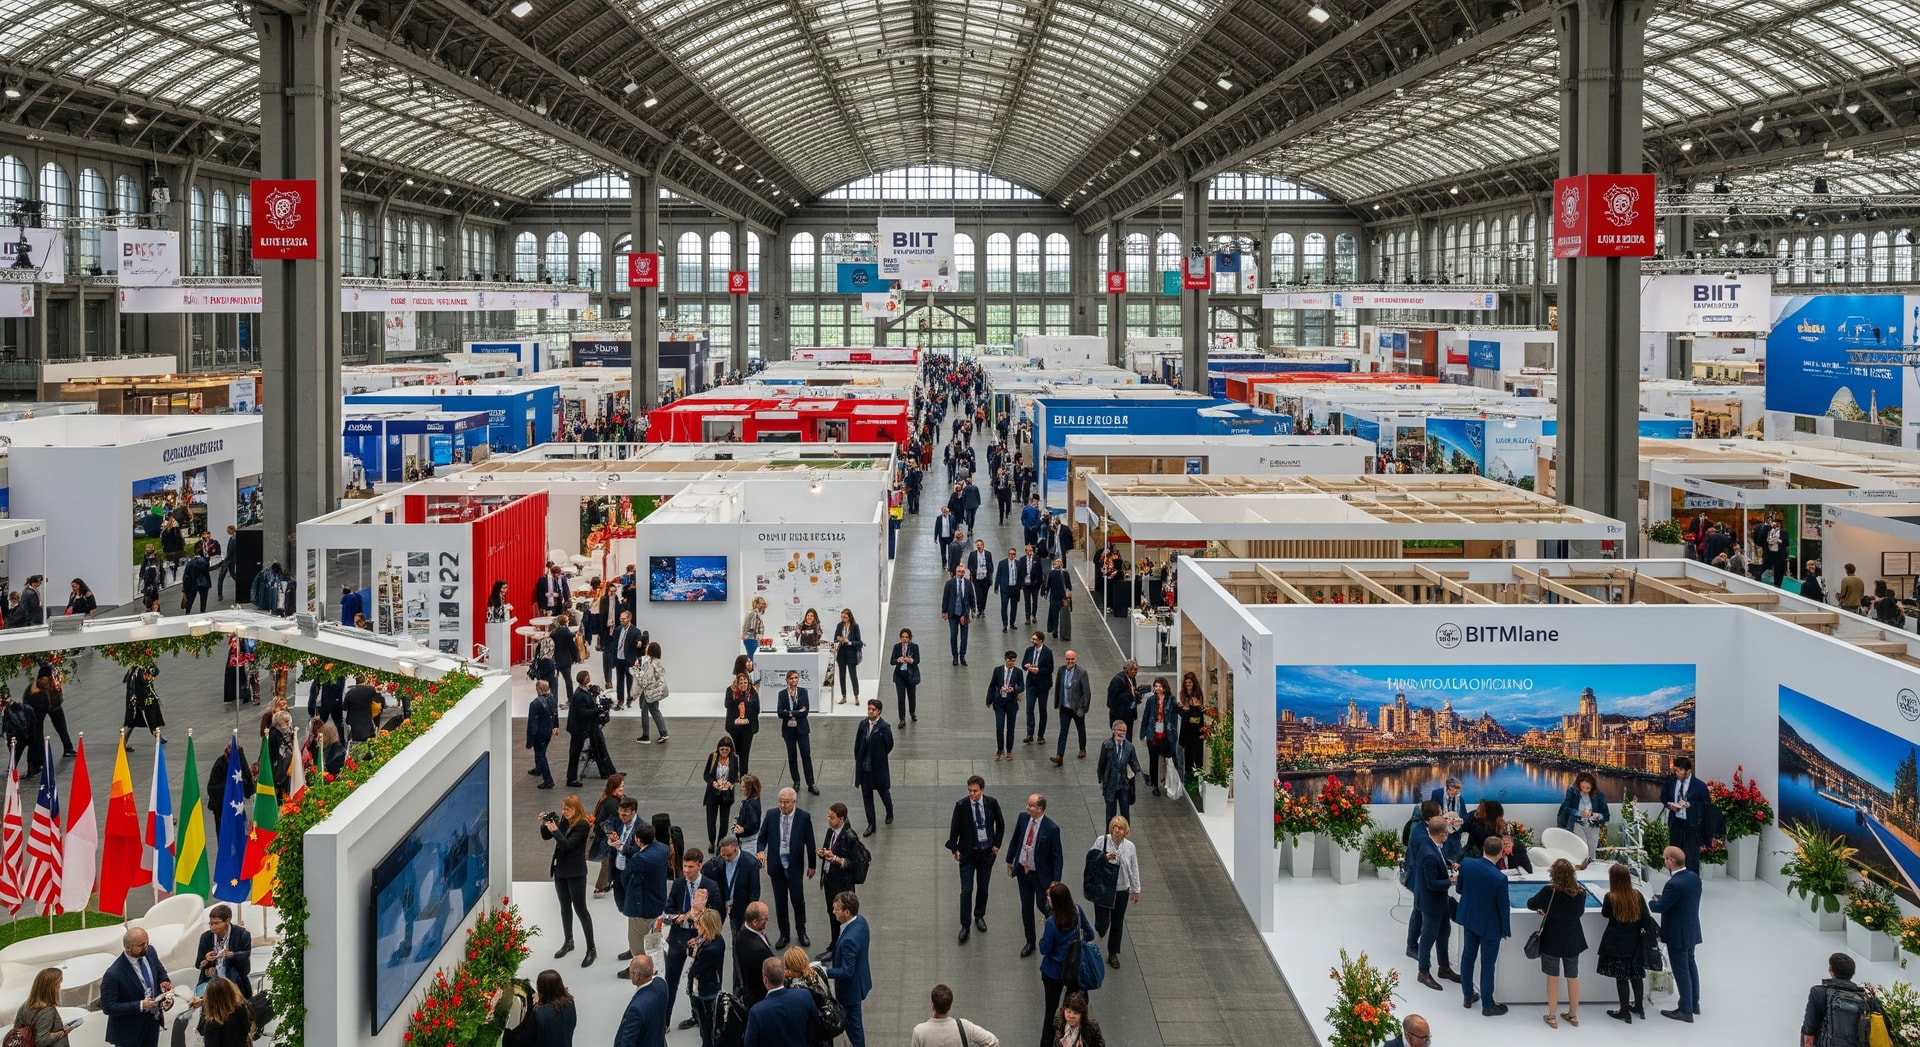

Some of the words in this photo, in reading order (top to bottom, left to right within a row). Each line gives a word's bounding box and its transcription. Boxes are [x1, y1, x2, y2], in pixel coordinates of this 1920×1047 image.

[892, 231, 939, 248] BIIT
[1693, 284, 1742, 302] BIIT
[1465, 625, 1560, 643] BITMlane
